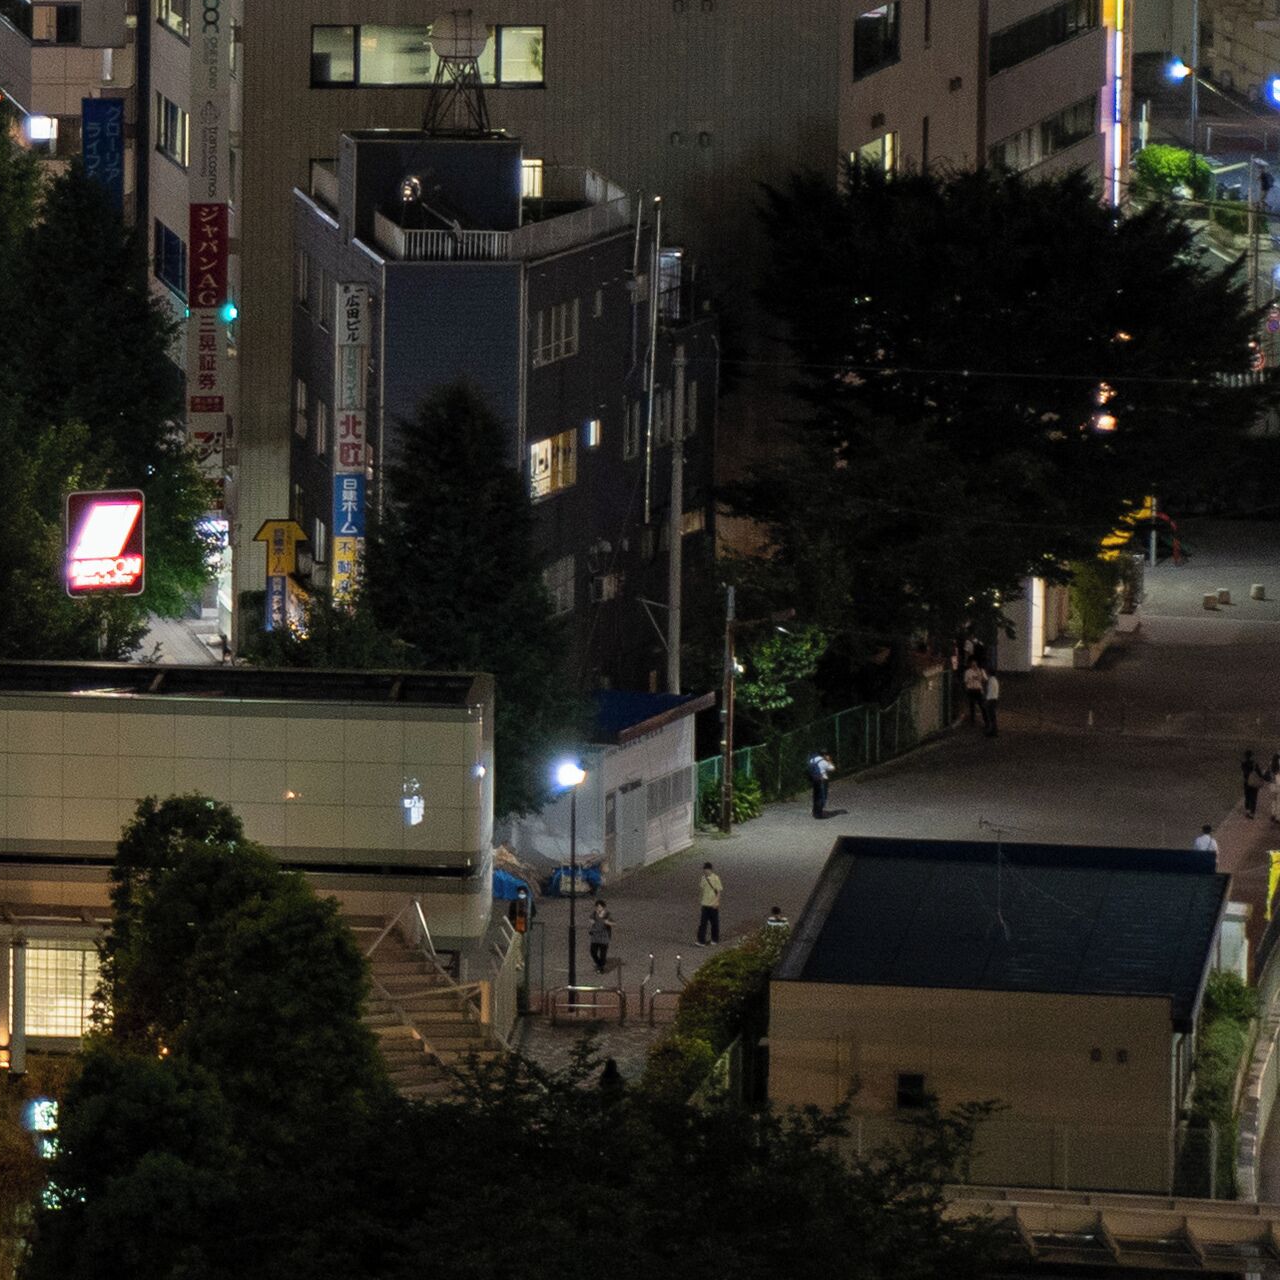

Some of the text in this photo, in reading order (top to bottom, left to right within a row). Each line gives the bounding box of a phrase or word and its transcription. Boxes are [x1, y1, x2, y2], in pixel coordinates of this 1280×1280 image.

[105, 106, 121, 184] グローリア
[207, 126, 218, 199] transcosmos
[197, 206, 220, 306] ジャパンAG
[198, 315, 218, 390] 三晃証券
[345, 294, 362, 343] 広田ビル
[340, 414, 363, 468] 北欧
[71, 558, 142, 577] NIPPON
